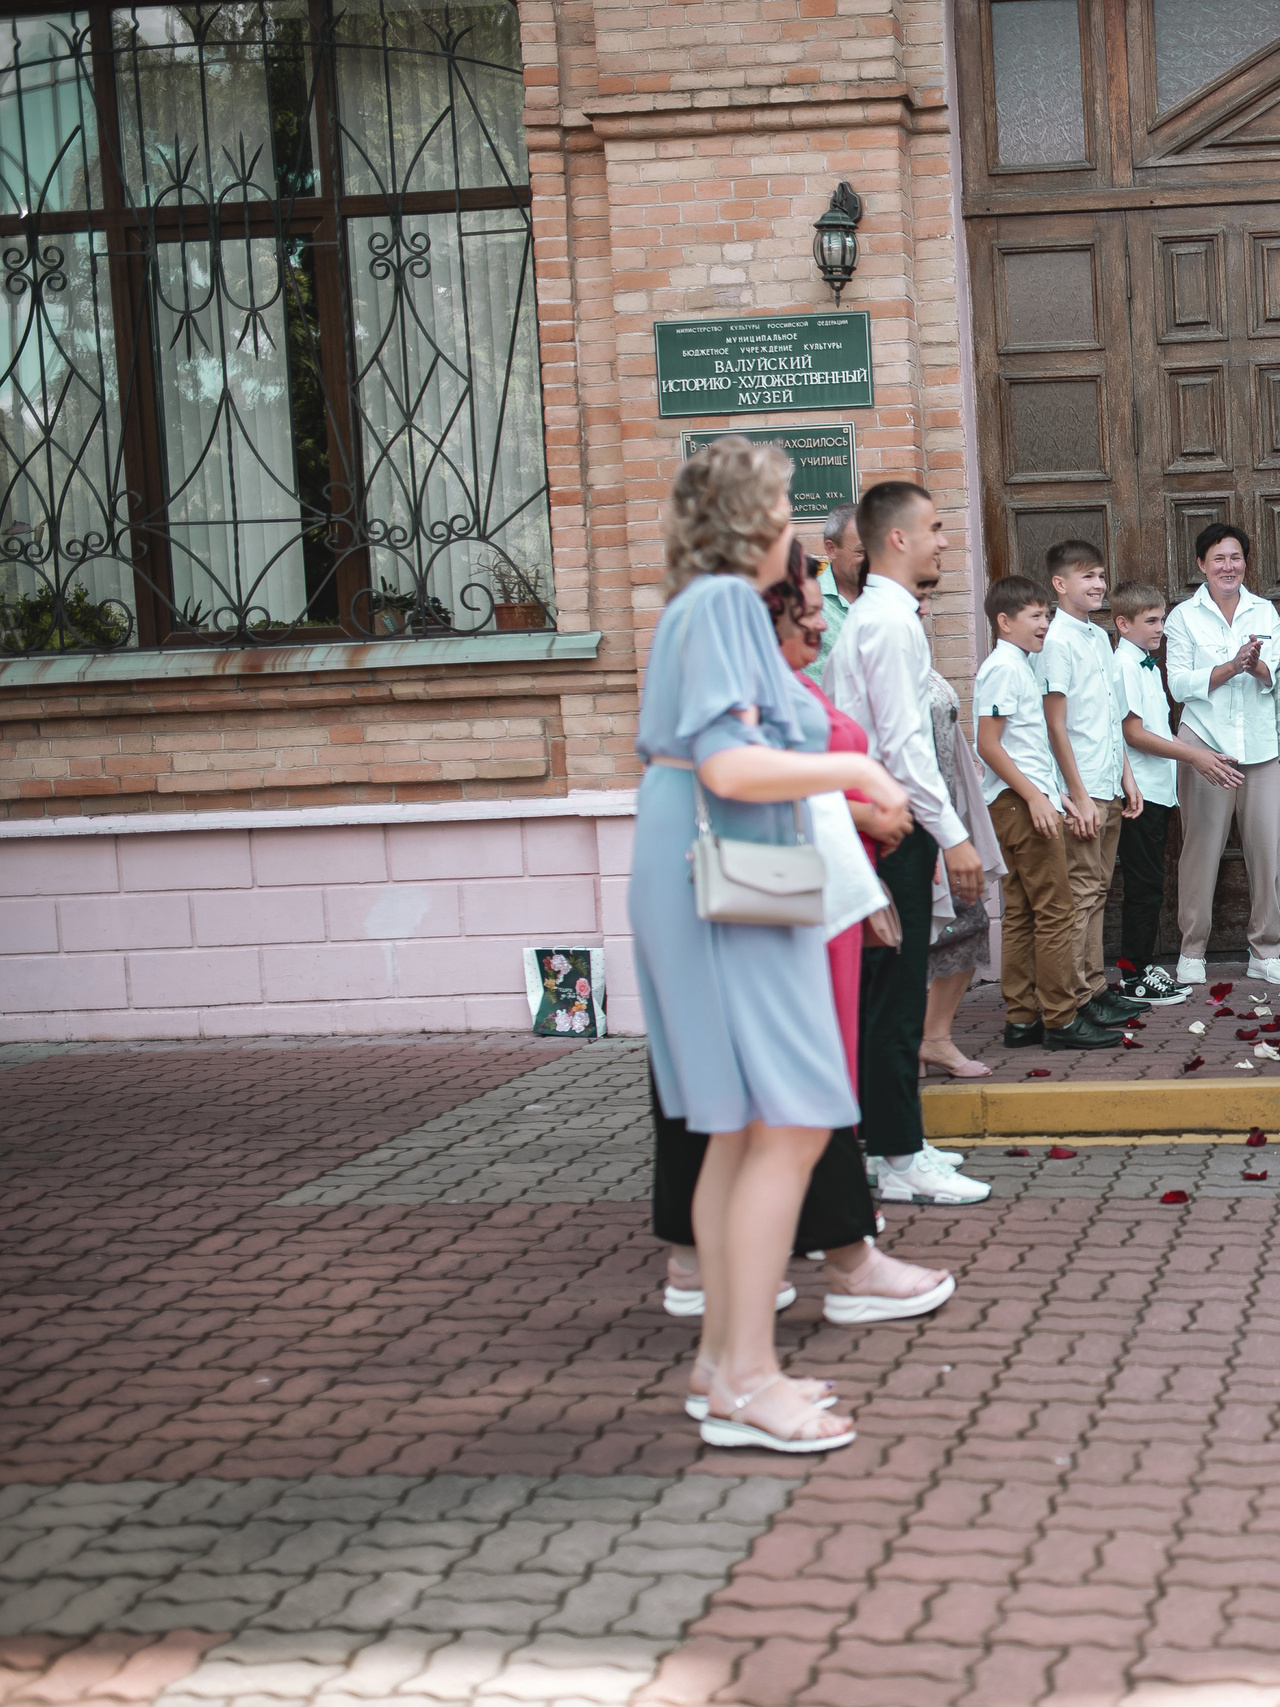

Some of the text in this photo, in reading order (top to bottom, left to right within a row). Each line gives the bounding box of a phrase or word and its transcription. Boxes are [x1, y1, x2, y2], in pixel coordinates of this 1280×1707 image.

[675, 326, 723, 334] МИНИСТЕРСТВО
[767, 321, 809, 329] РОССИЙСКОЙ
[817, 319, 849, 327] ФЕДЕРАЦИИ
[725, 333, 798, 344] МУНИЦИПАЛЬНОЕ
[682, 342, 842, 357] БЮДЖЕТНОЕ УЧРЕЖДЕНИЕ КУЛЬТУРЫ
[714, 354, 813, 374] ВАЛУЙСКИЙ
[738, 389, 794, 406] МУЗЕЙ
[690, 441, 697, 453] В
[778, 436, 849, 449] НАХОДИЛОСЬ
[800, 455, 848, 467] УЧИЛИЩЕ
[794, 492, 821, 500] КОНЦА
[825, 491, 838, 499] XIX
